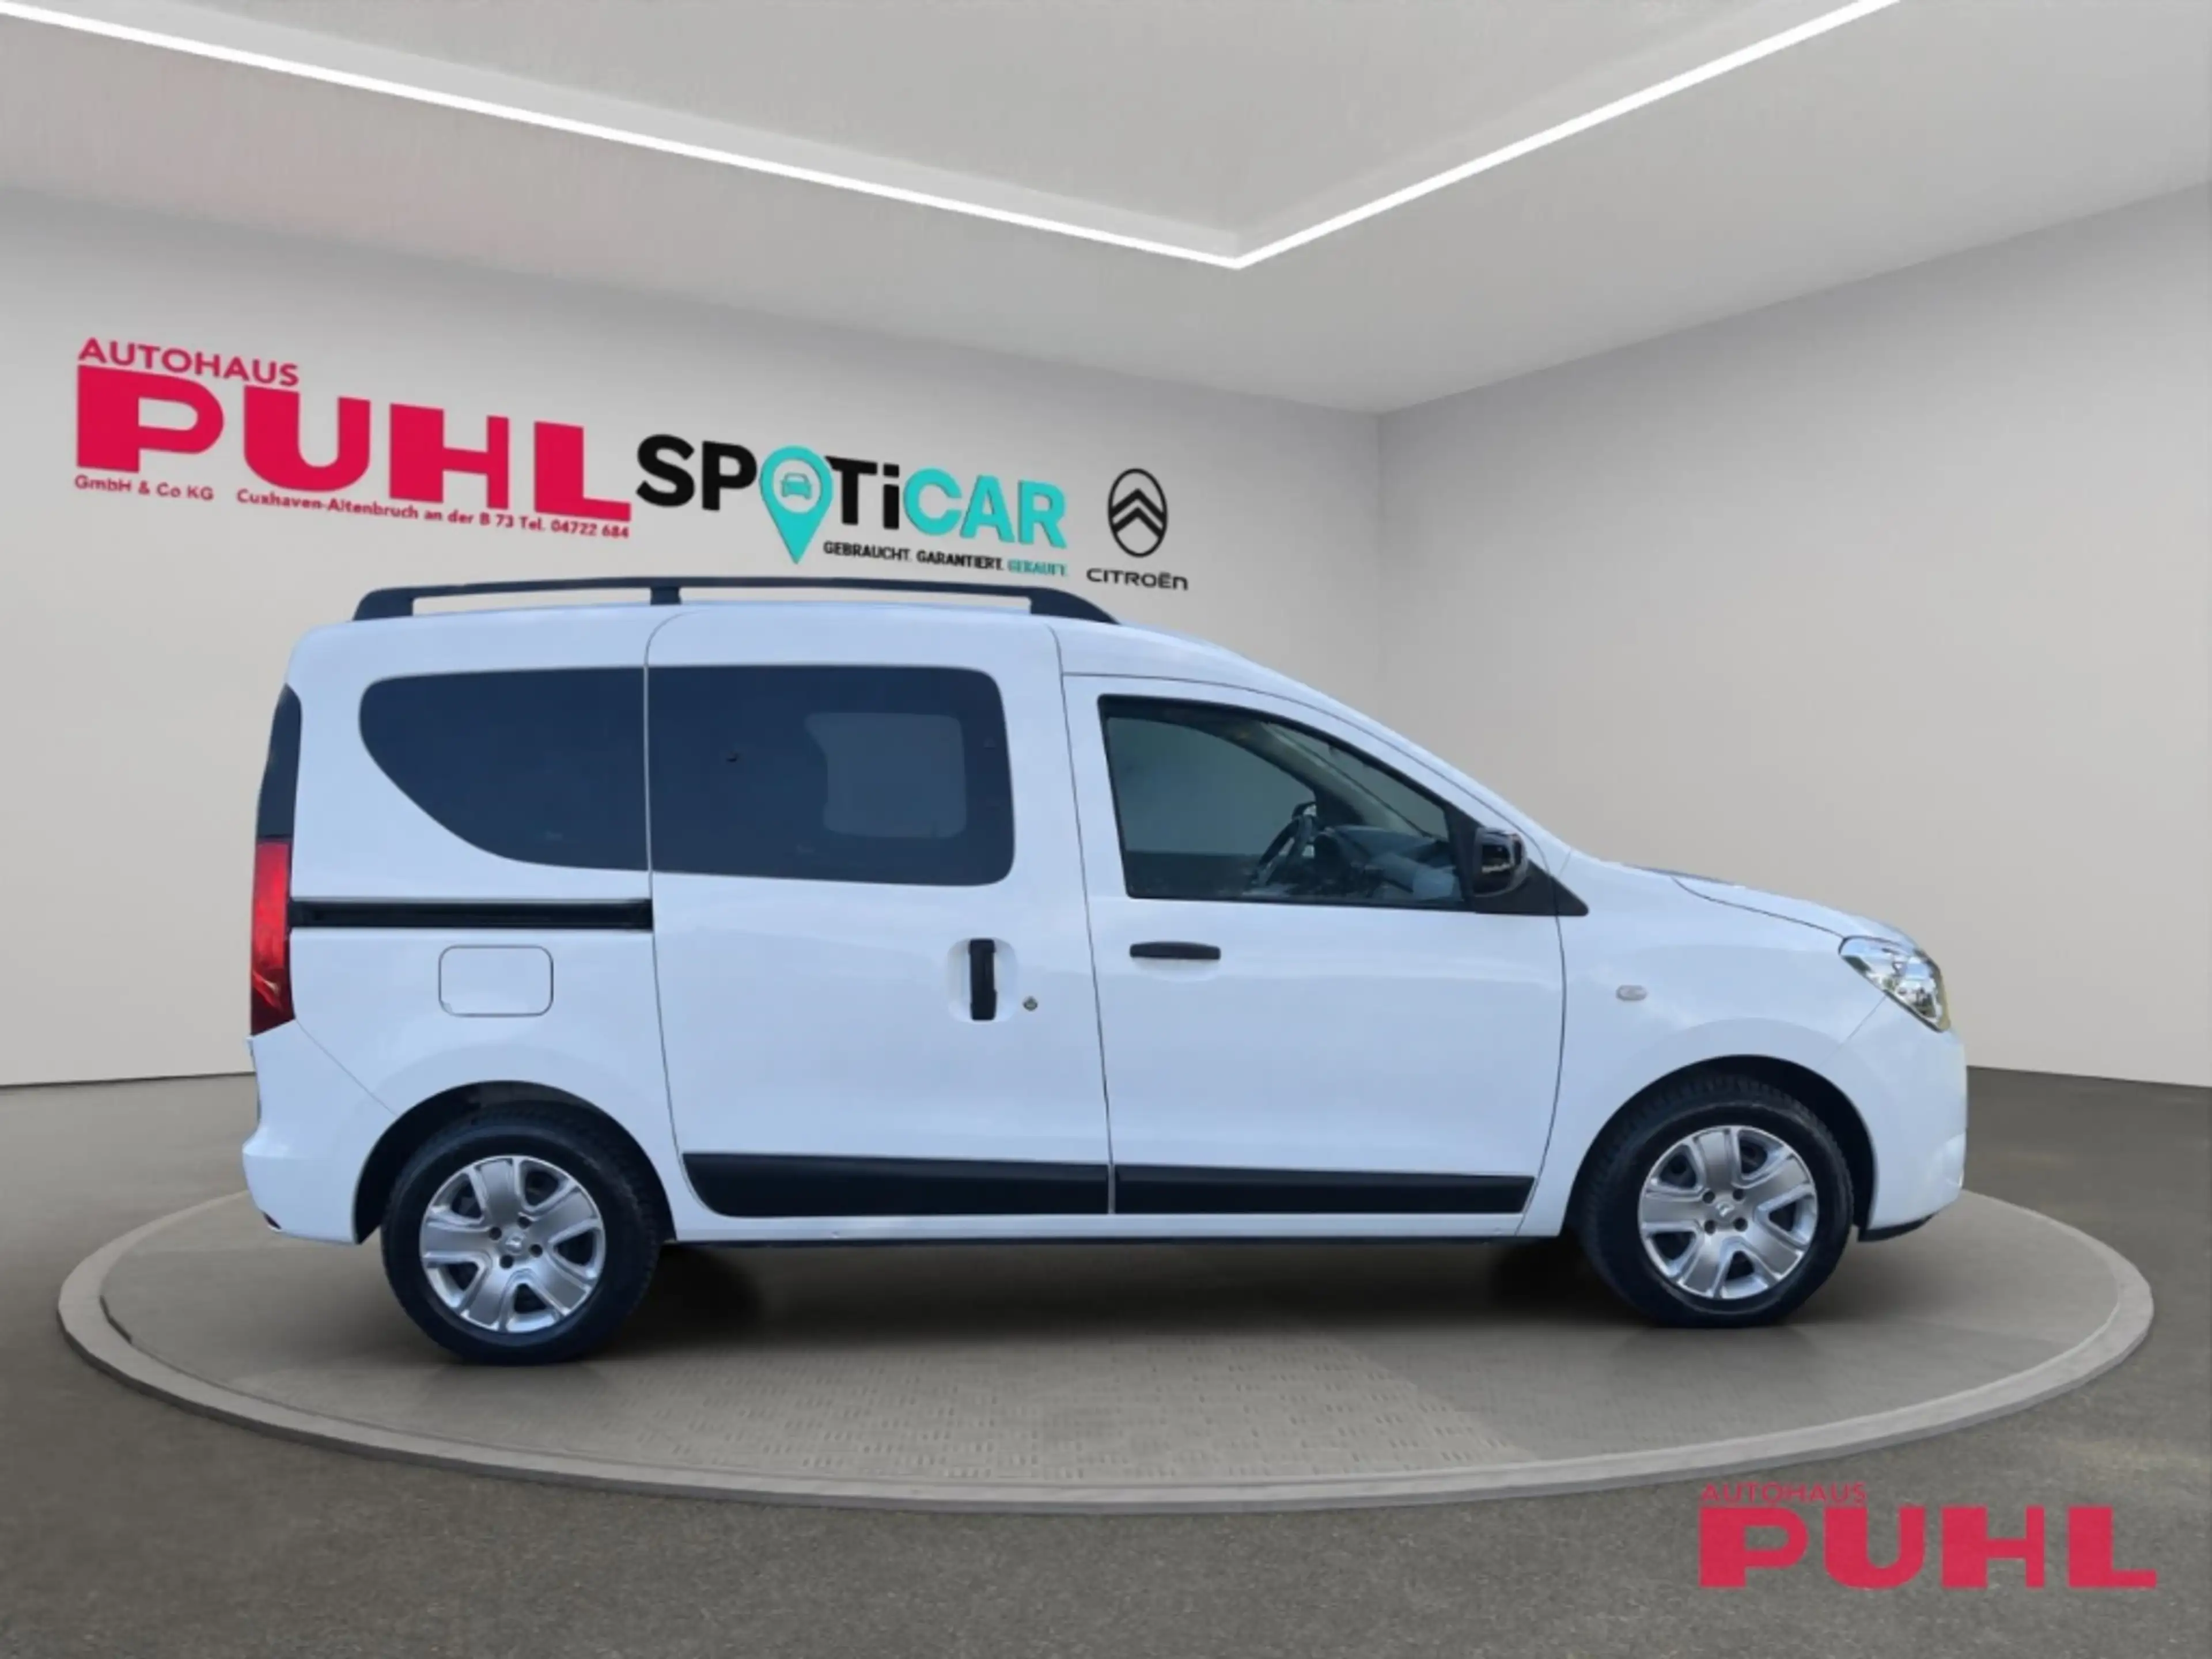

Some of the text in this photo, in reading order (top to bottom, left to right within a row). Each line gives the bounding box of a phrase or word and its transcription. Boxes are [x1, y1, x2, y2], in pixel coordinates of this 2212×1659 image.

[78, 337, 298, 387] AUTOHAUS
[77, 365, 631, 521] PUHL
[74, 475, 131, 492] GmbH
[138, 481, 150, 495] &
[157, 483, 180, 498] Co
[187, 485, 214, 501] KG
[424, 510, 442, 522] an
[448, 510, 473, 525] der
[479, 513, 490, 526] B
[496, 514, 514, 528] 73
[521, 516, 544, 531] Tel.
[551, 518, 597, 536] 04722
[601, 526, 630, 539] 684
